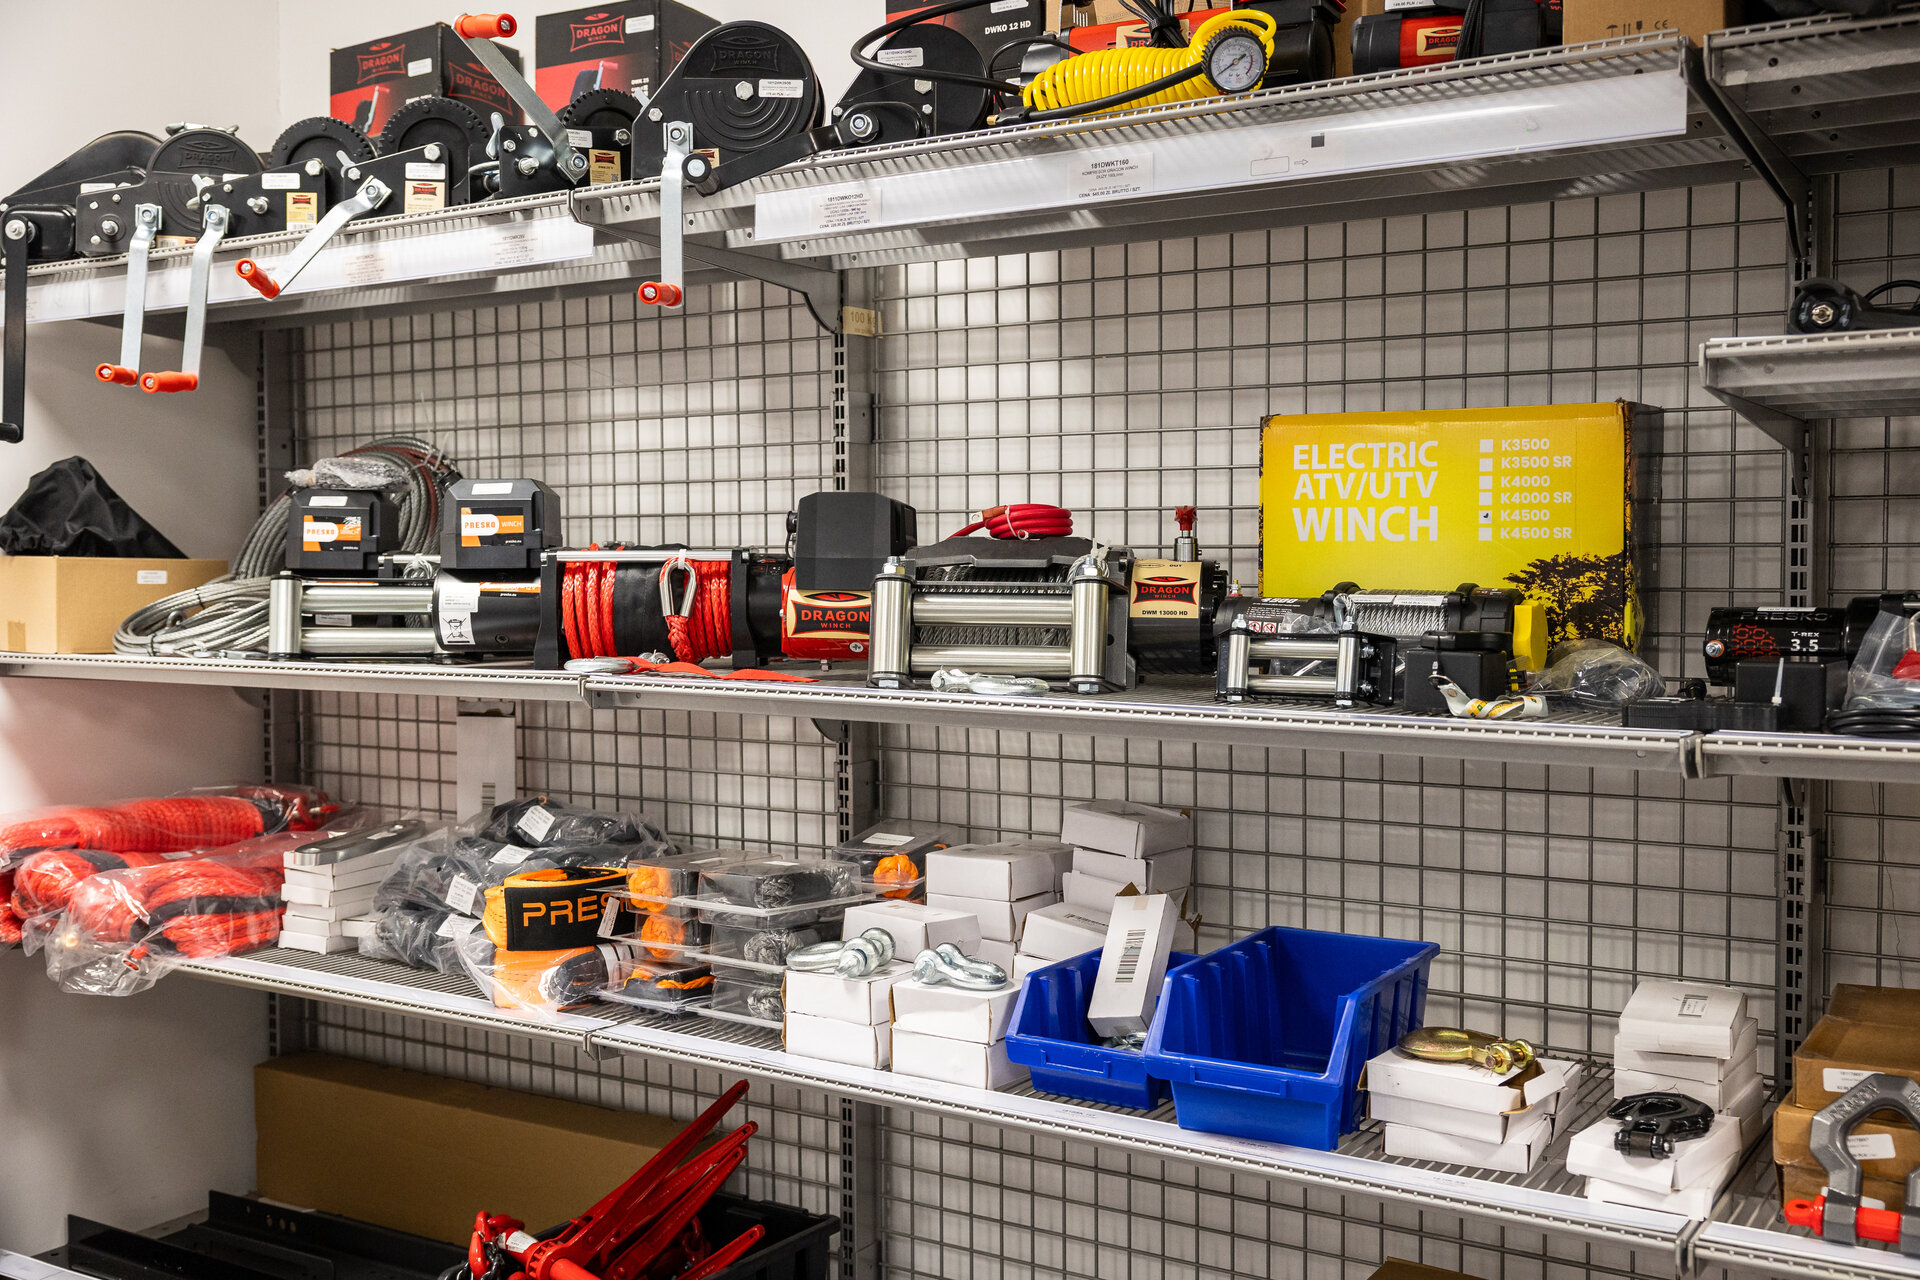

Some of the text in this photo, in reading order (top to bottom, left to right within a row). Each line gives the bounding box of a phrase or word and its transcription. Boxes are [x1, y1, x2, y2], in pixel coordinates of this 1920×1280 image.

[576, 24, 618, 39] DRAGON
[984, 20, 1032, 35] DWKO 12 HD
[362, 53, 399, 70] DRAGON
[720, 51, 772, 59] DRAGON
[851, 311, 865, 323] 100
[1501, 438, 1550, 451] K3500
[1293, 440, 1438, 470] ELECTRIC
[1501, 455, 1572, 469] K3500 SR
[1293, 470, 1438, 500] ATV/UTV
[1500, 475, 1550, 488] K4000
[1500, 491, 1572, 505] K4000 SR
[1500, 509, 1550, 522] K4500
[464, 520, 522, 529] PRESKO WINCH
[1292, 506, 1438, 542] WINCH
[1500, 527, 1572, 539] K4500 SR
[1141, 586, 1190, 594] DRAGON
[801, 610, 870, 622] DRAGON
[1740, 611, 1829, 621] PRESKO
[1790, 638, 1819, 652] 3.5
